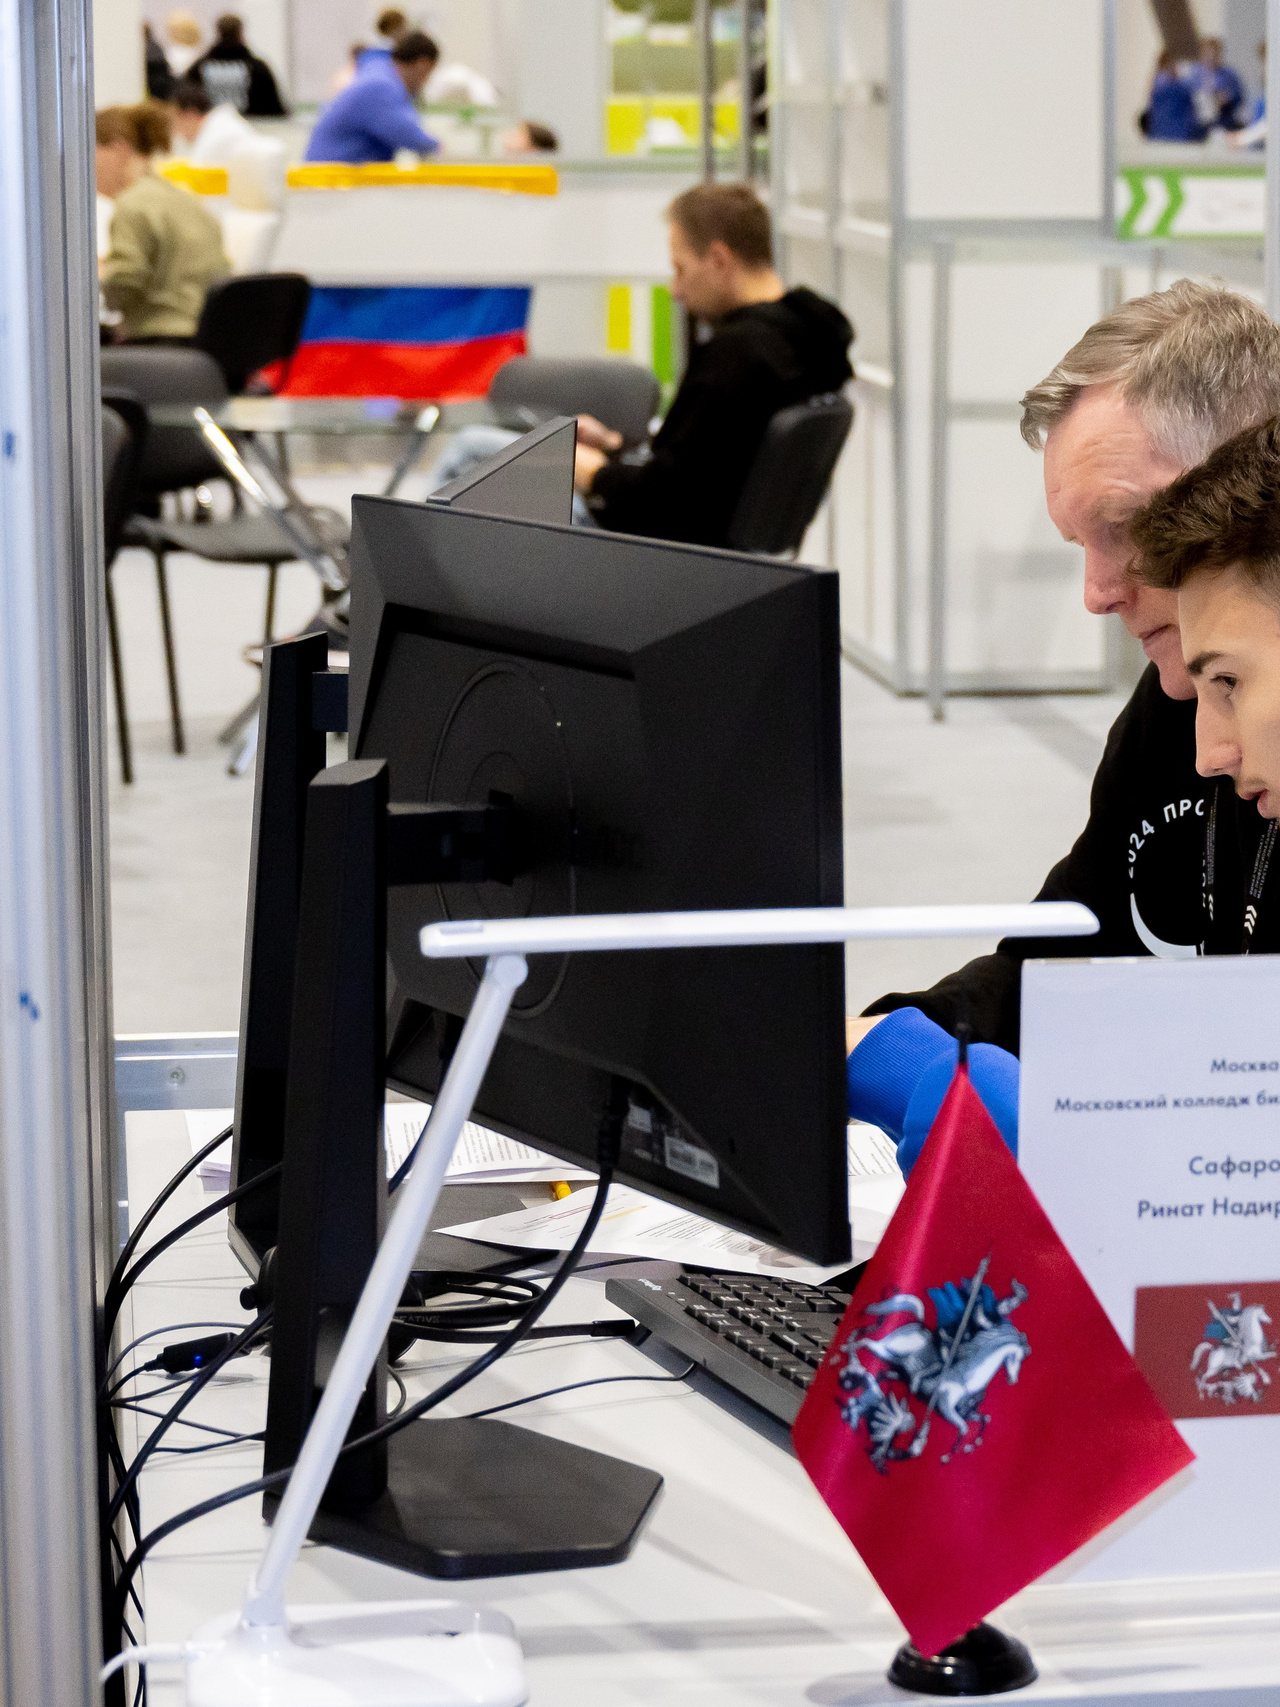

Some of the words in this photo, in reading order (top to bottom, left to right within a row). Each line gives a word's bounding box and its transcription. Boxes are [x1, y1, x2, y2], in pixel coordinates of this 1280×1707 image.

[1210, 1058, 1280, 1074] Москва
[1054, 1094, 1167, 1113] Московский
[1172, 1094, 1250, 1108] колледж
[1137, 1199, 1205, 1219] Ринат
